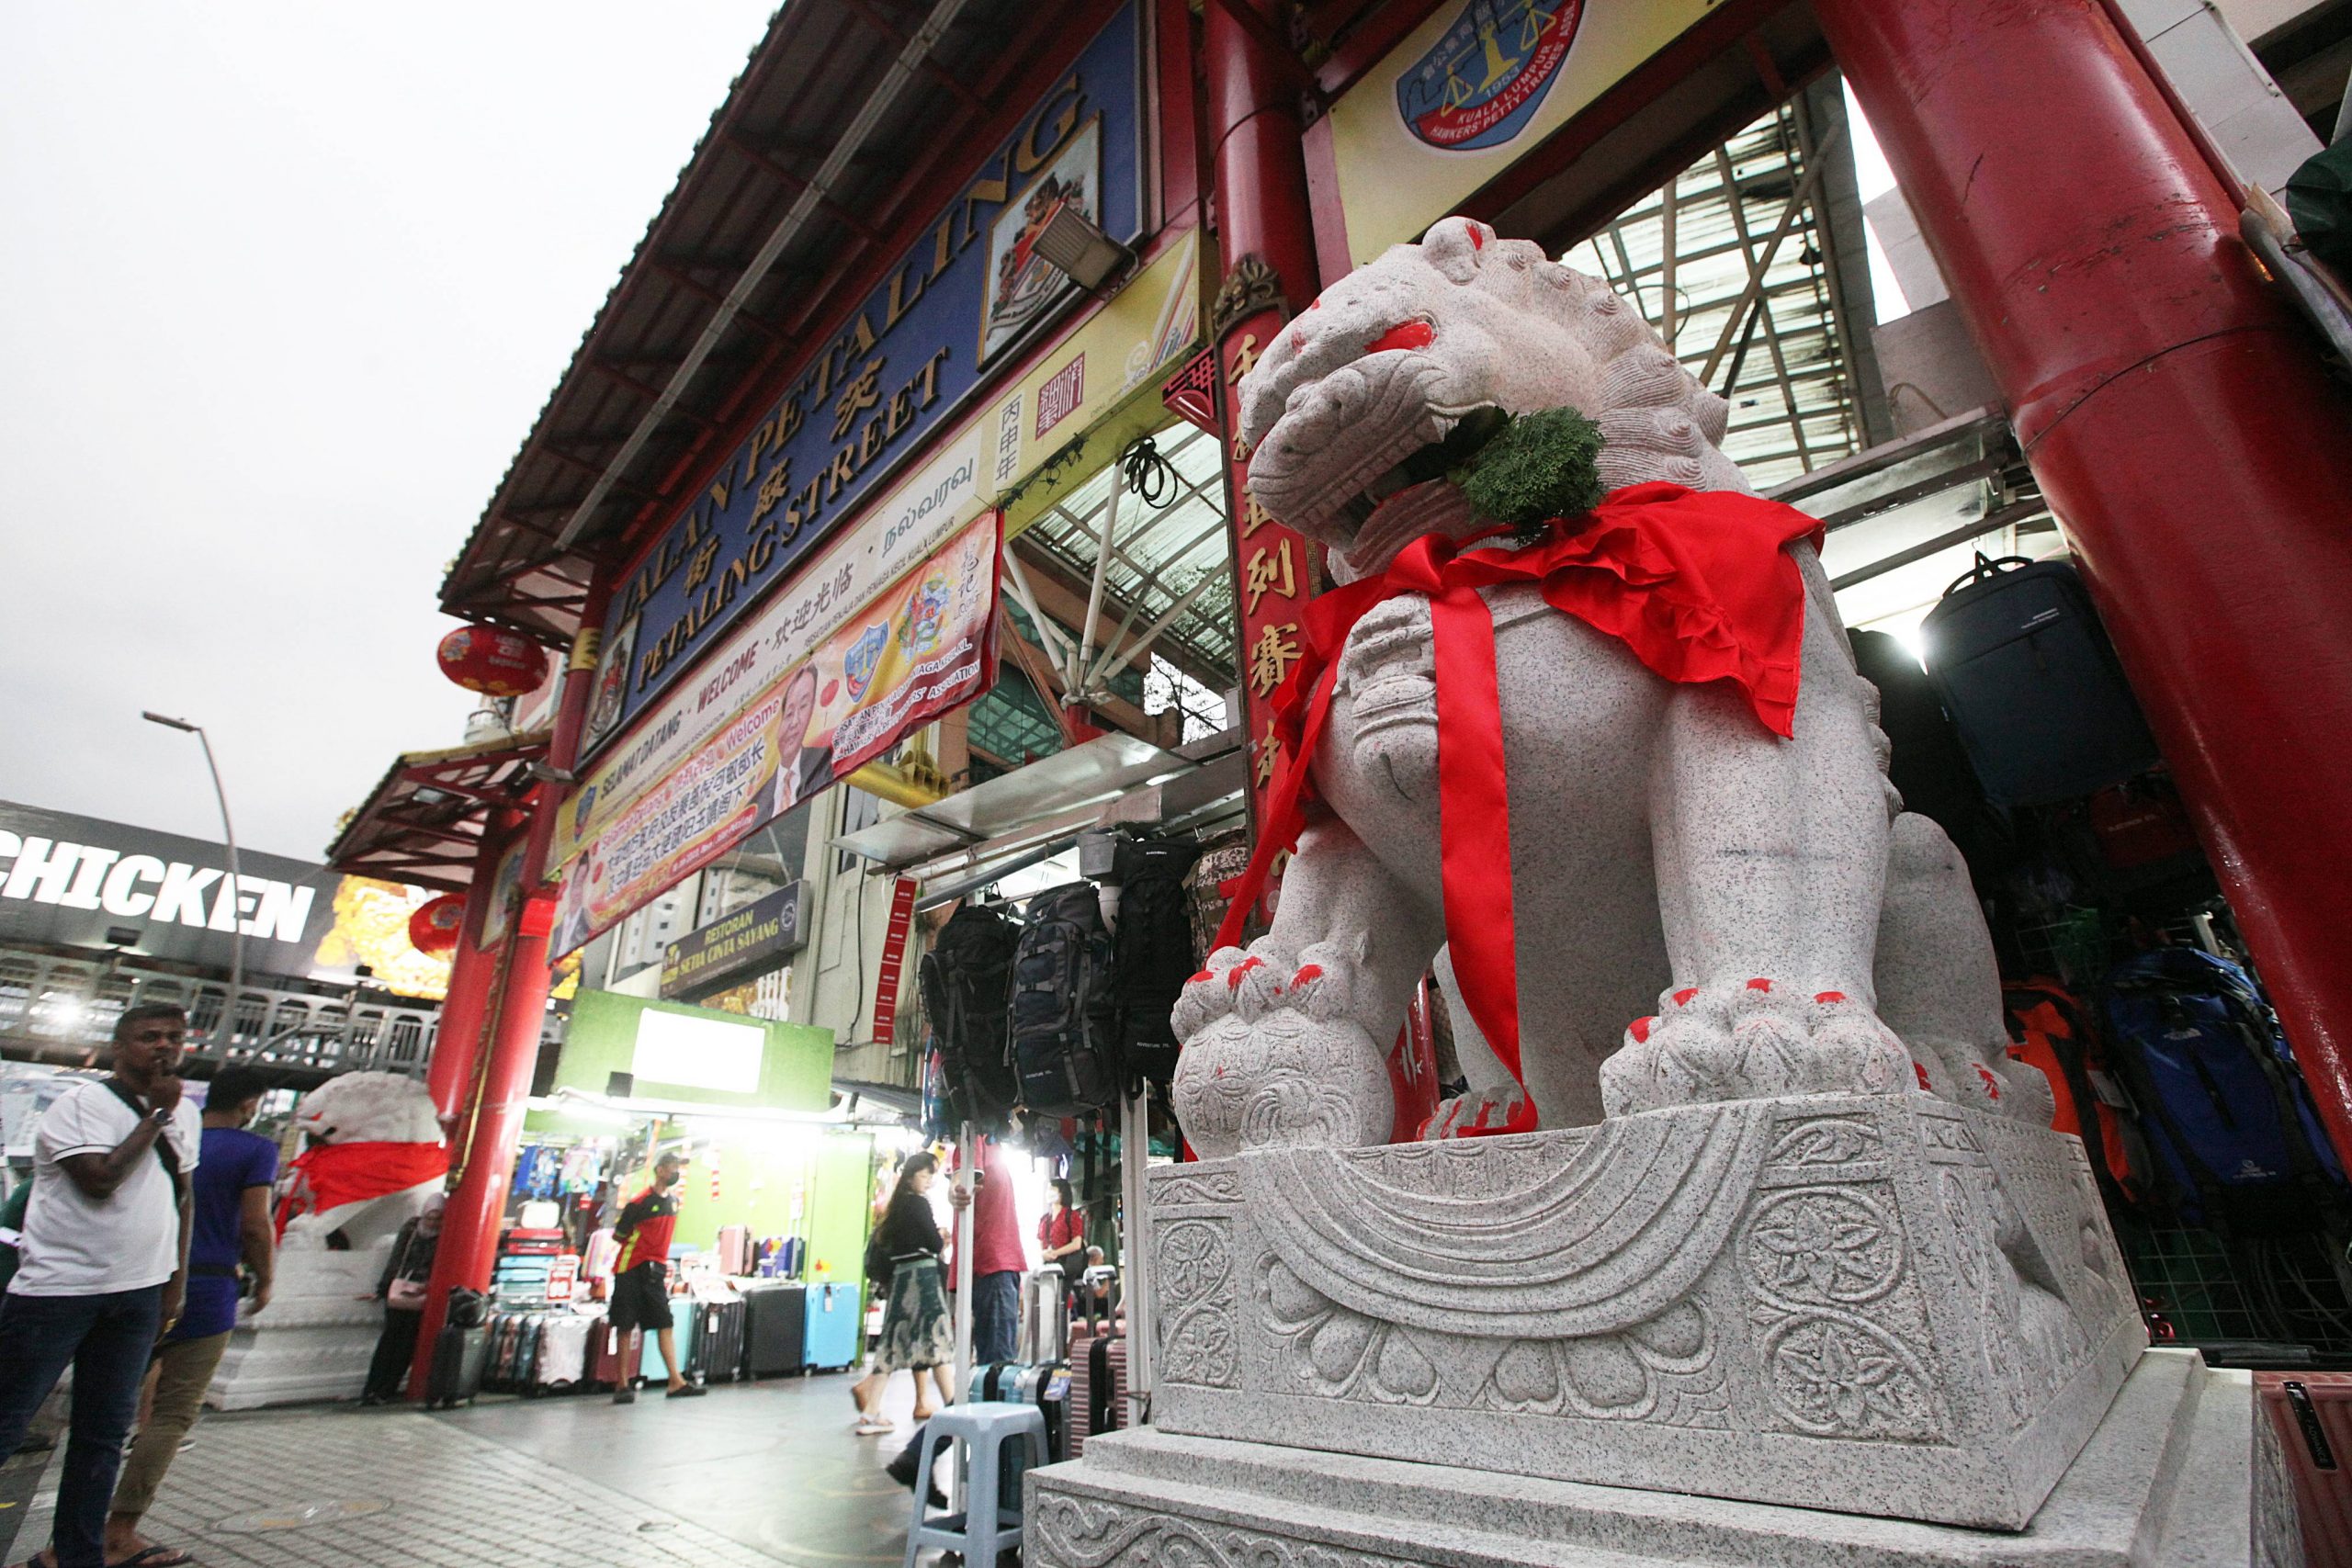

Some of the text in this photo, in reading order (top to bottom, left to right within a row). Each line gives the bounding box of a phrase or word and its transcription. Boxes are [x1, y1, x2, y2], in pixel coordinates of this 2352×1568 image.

[1457, 43, 1551, 124] KUALA LUMPUR
[1483, 96, 1521, 129] PETTY
[614, 72, 1086, 636] JALAN PETALING
[996, 393, 1023, 480] 丙申年
[638, 520, 778, 693] PETALING
[781, 346, 950, 546] STREET
[882, 457, 975, 558] நல்வரவு
[772, 562, 854, 651] 欢迎光临
[640, 709, 683, 765] DATANG
[696, 641, 759, 714] WELCOME
[726, 696, 780, 751] Welcome
[705, 909, 754, 945] RESTORAN
[707, 938, 735, 964] CINTA
[737, 918, 779, 952] SAYANG
